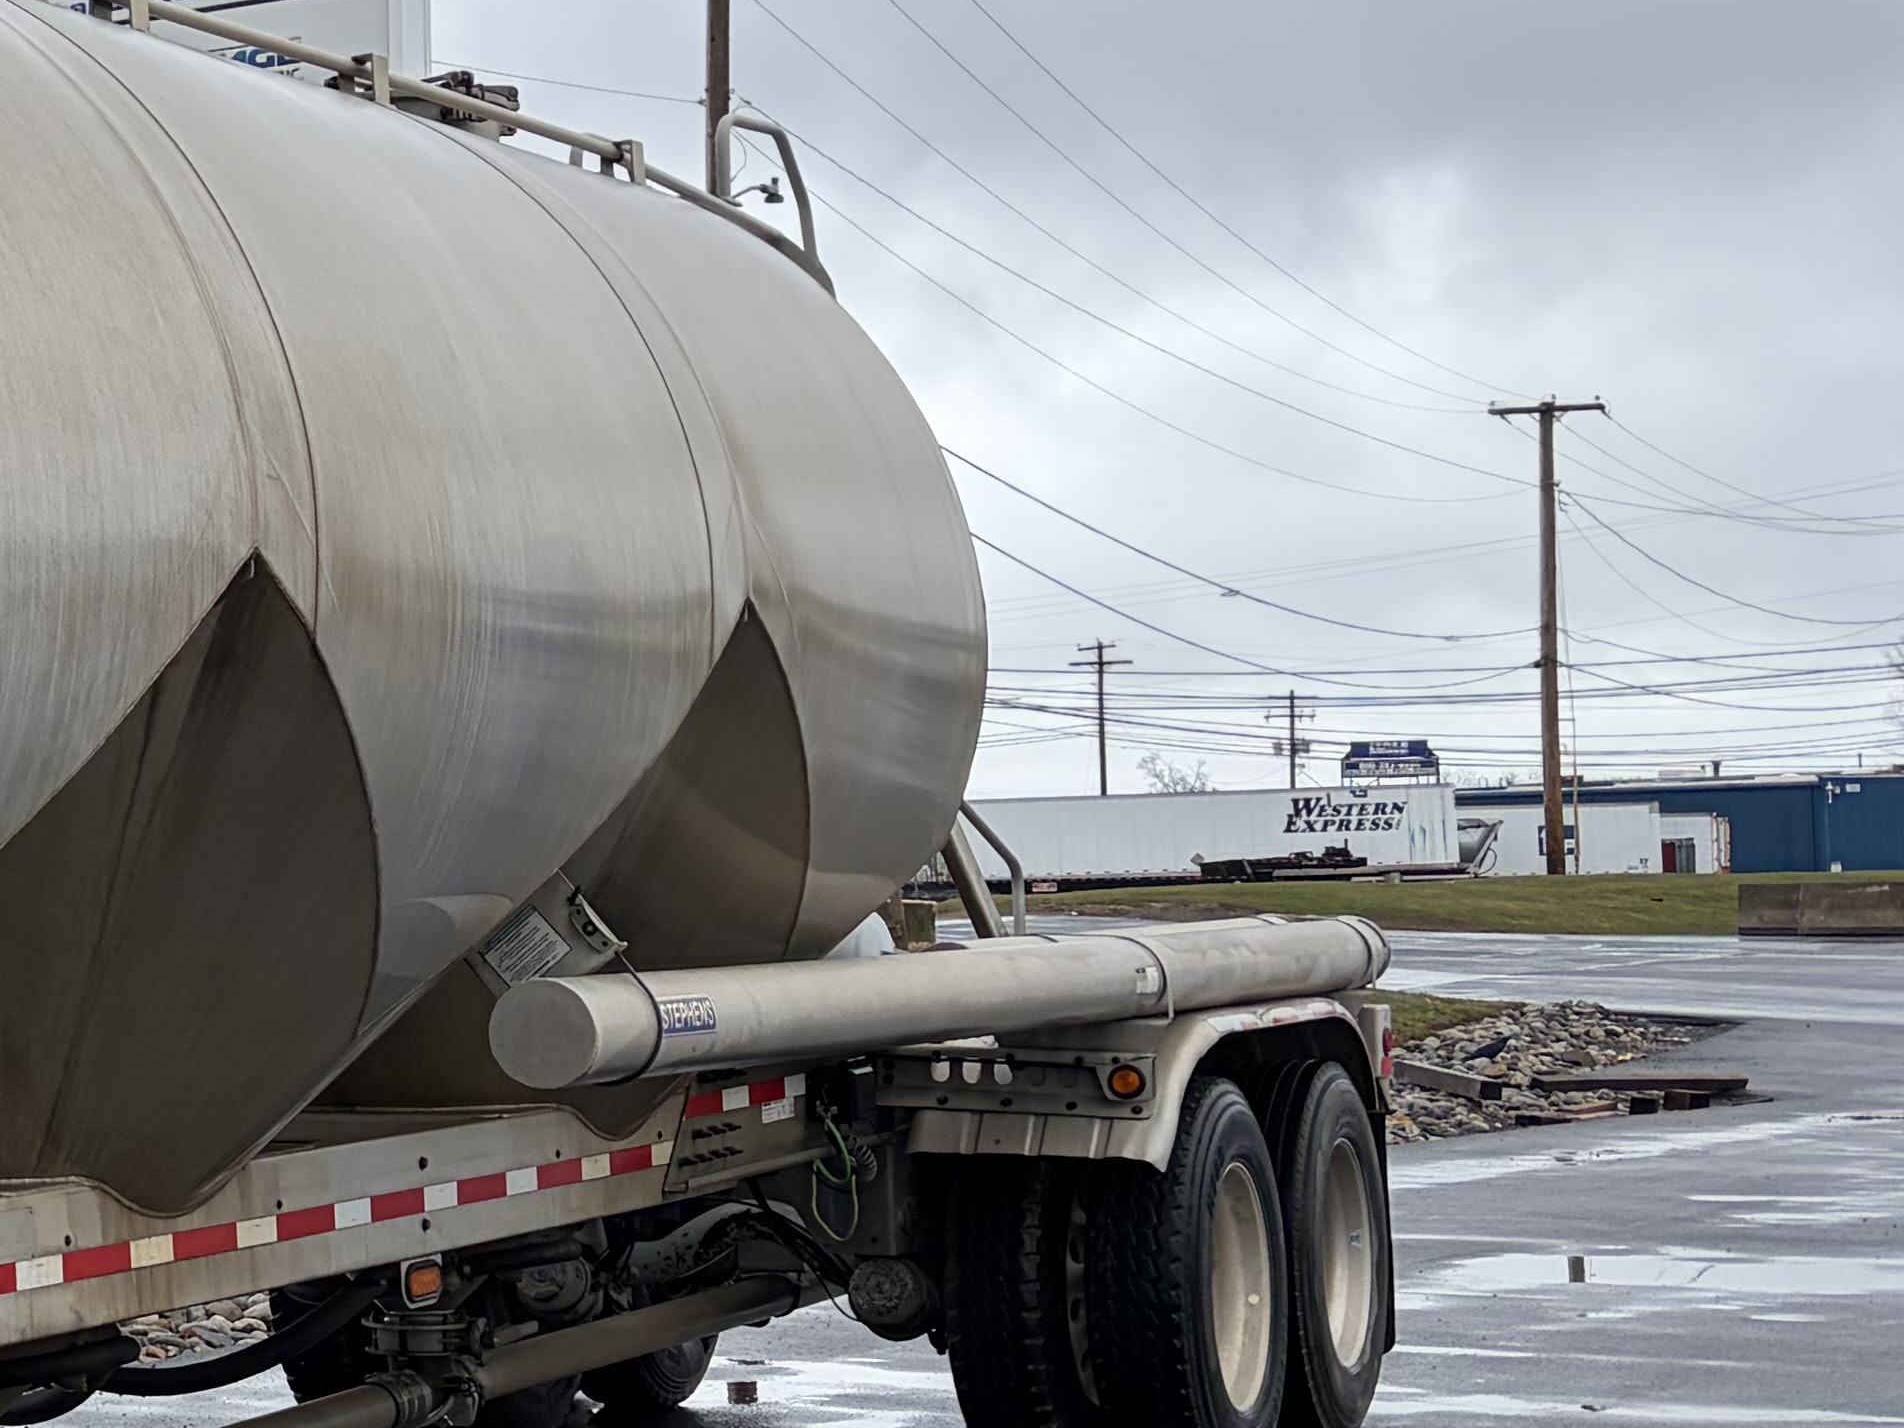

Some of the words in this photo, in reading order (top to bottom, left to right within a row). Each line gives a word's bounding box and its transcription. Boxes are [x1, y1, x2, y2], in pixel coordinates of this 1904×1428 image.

[1290, 796, 1408, 818] WESTERN
[1283, 813, 1394, 834] EXPRESS
[659, 999, 714, 1030] STEPHENS
